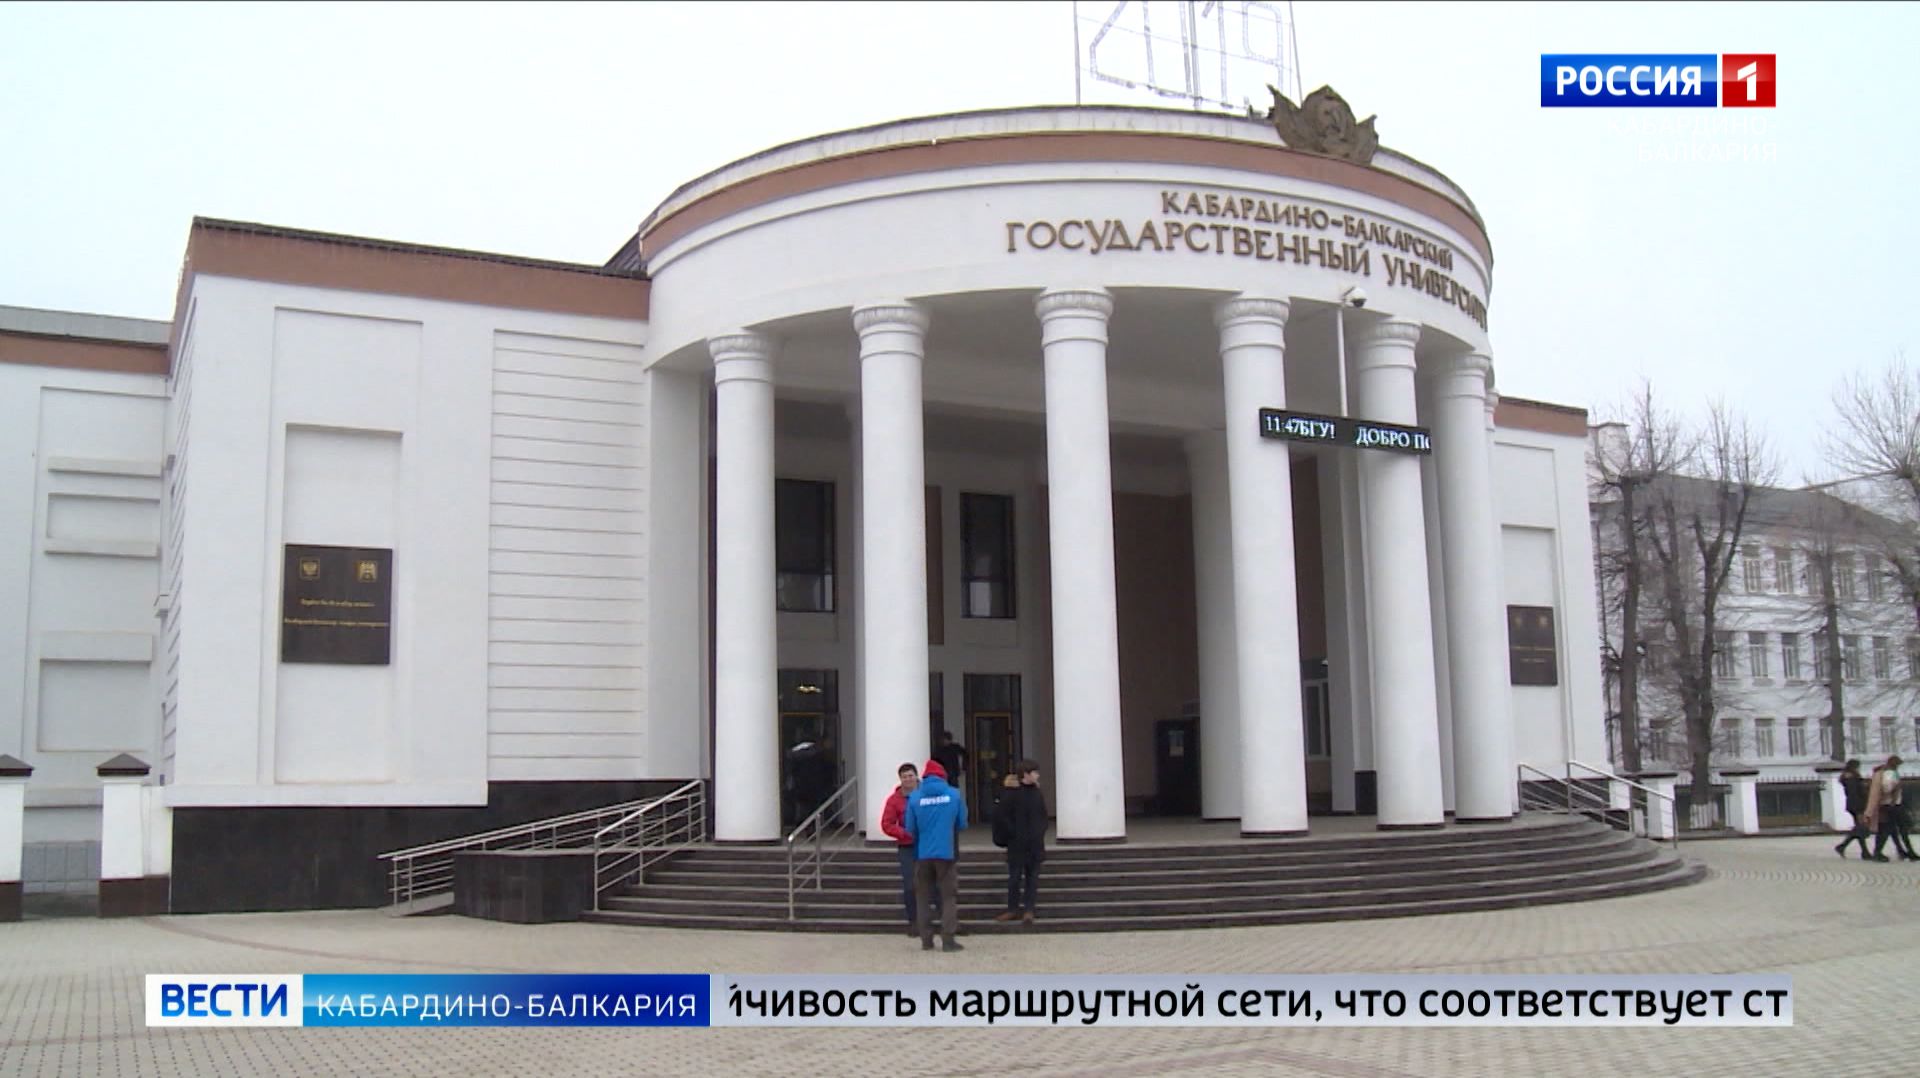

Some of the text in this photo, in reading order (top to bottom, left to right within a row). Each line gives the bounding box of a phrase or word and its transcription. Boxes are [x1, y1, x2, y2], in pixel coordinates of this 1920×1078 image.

[1161, 191, 1452, 271] КАБАРДИНО-БАЛКАРСКИЙ
[1006, 220, 1488, 333] ГОСУДАРСТВЕННЫЙ УНИВЕРСИ
[1356, 427, 1410, 447] ДОБРО
